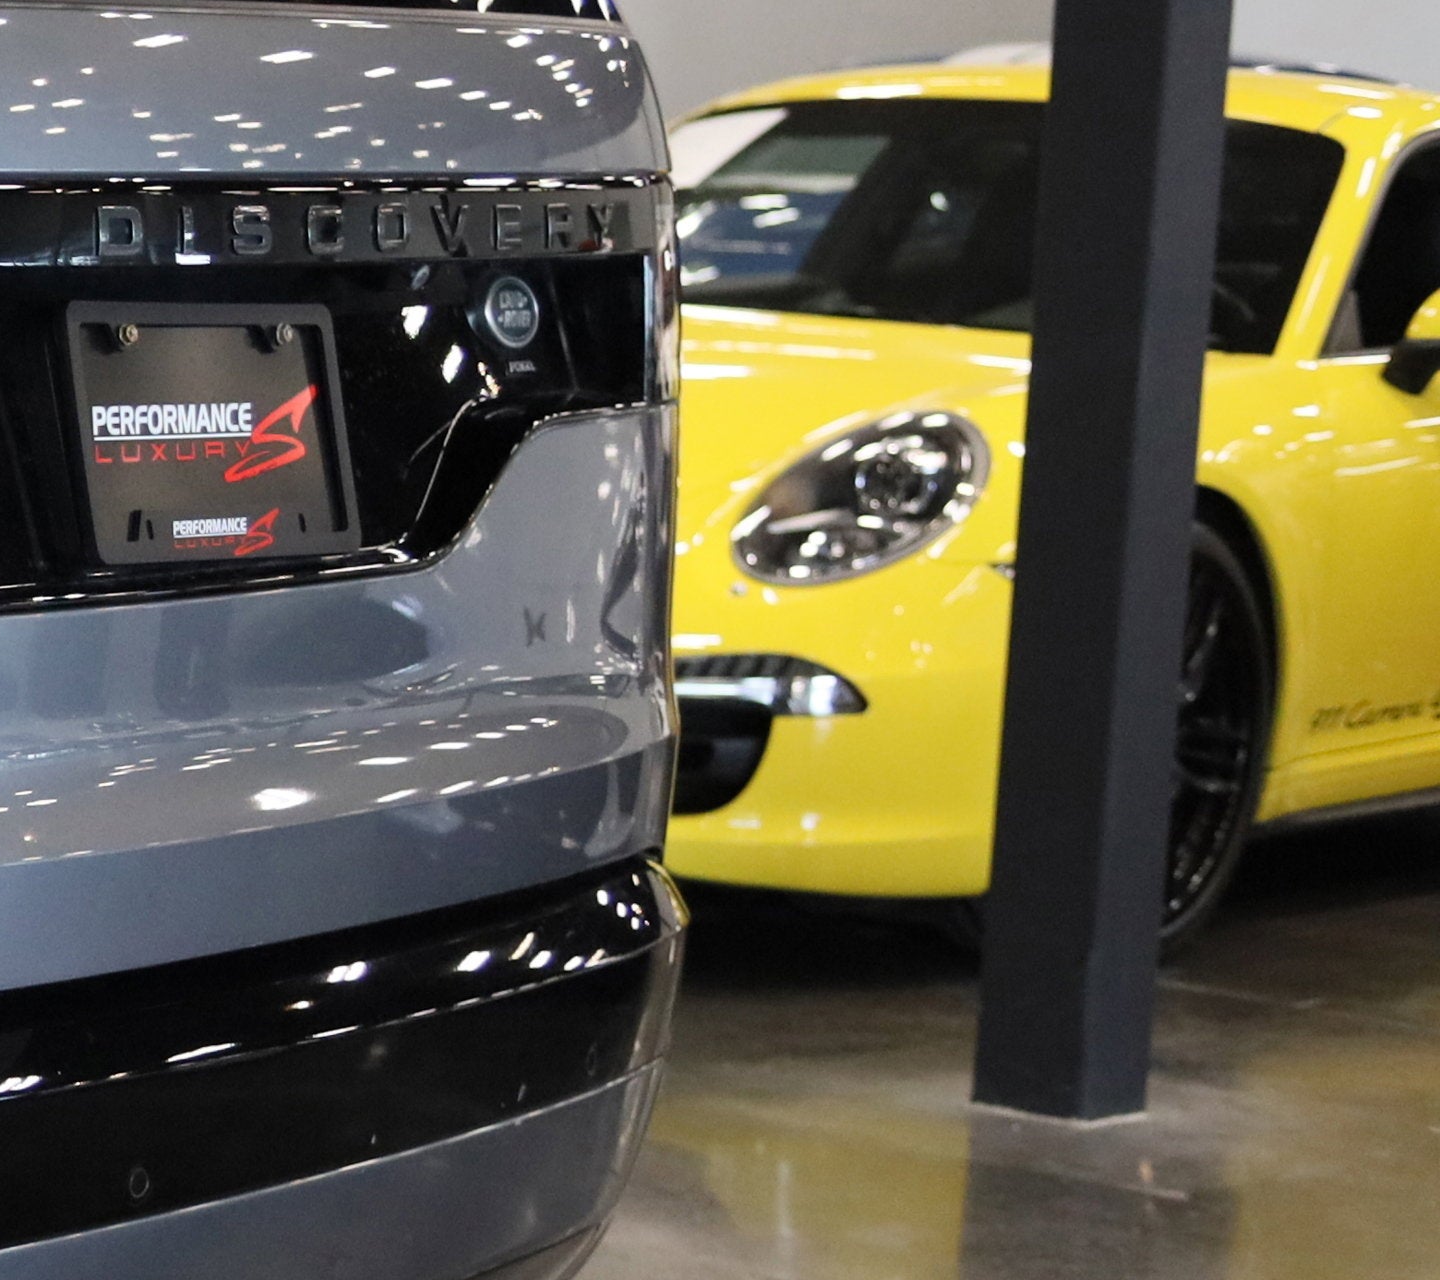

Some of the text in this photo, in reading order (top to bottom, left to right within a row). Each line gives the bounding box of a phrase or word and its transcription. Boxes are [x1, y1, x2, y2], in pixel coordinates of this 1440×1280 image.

[95, 202, 618, 256] DISCOVERY
[91, 402, 252, 436] PERFORMANCE
[94, 440, 251, 464] LUXURY
[172, 516, 248, 536] PERFORMANCE
